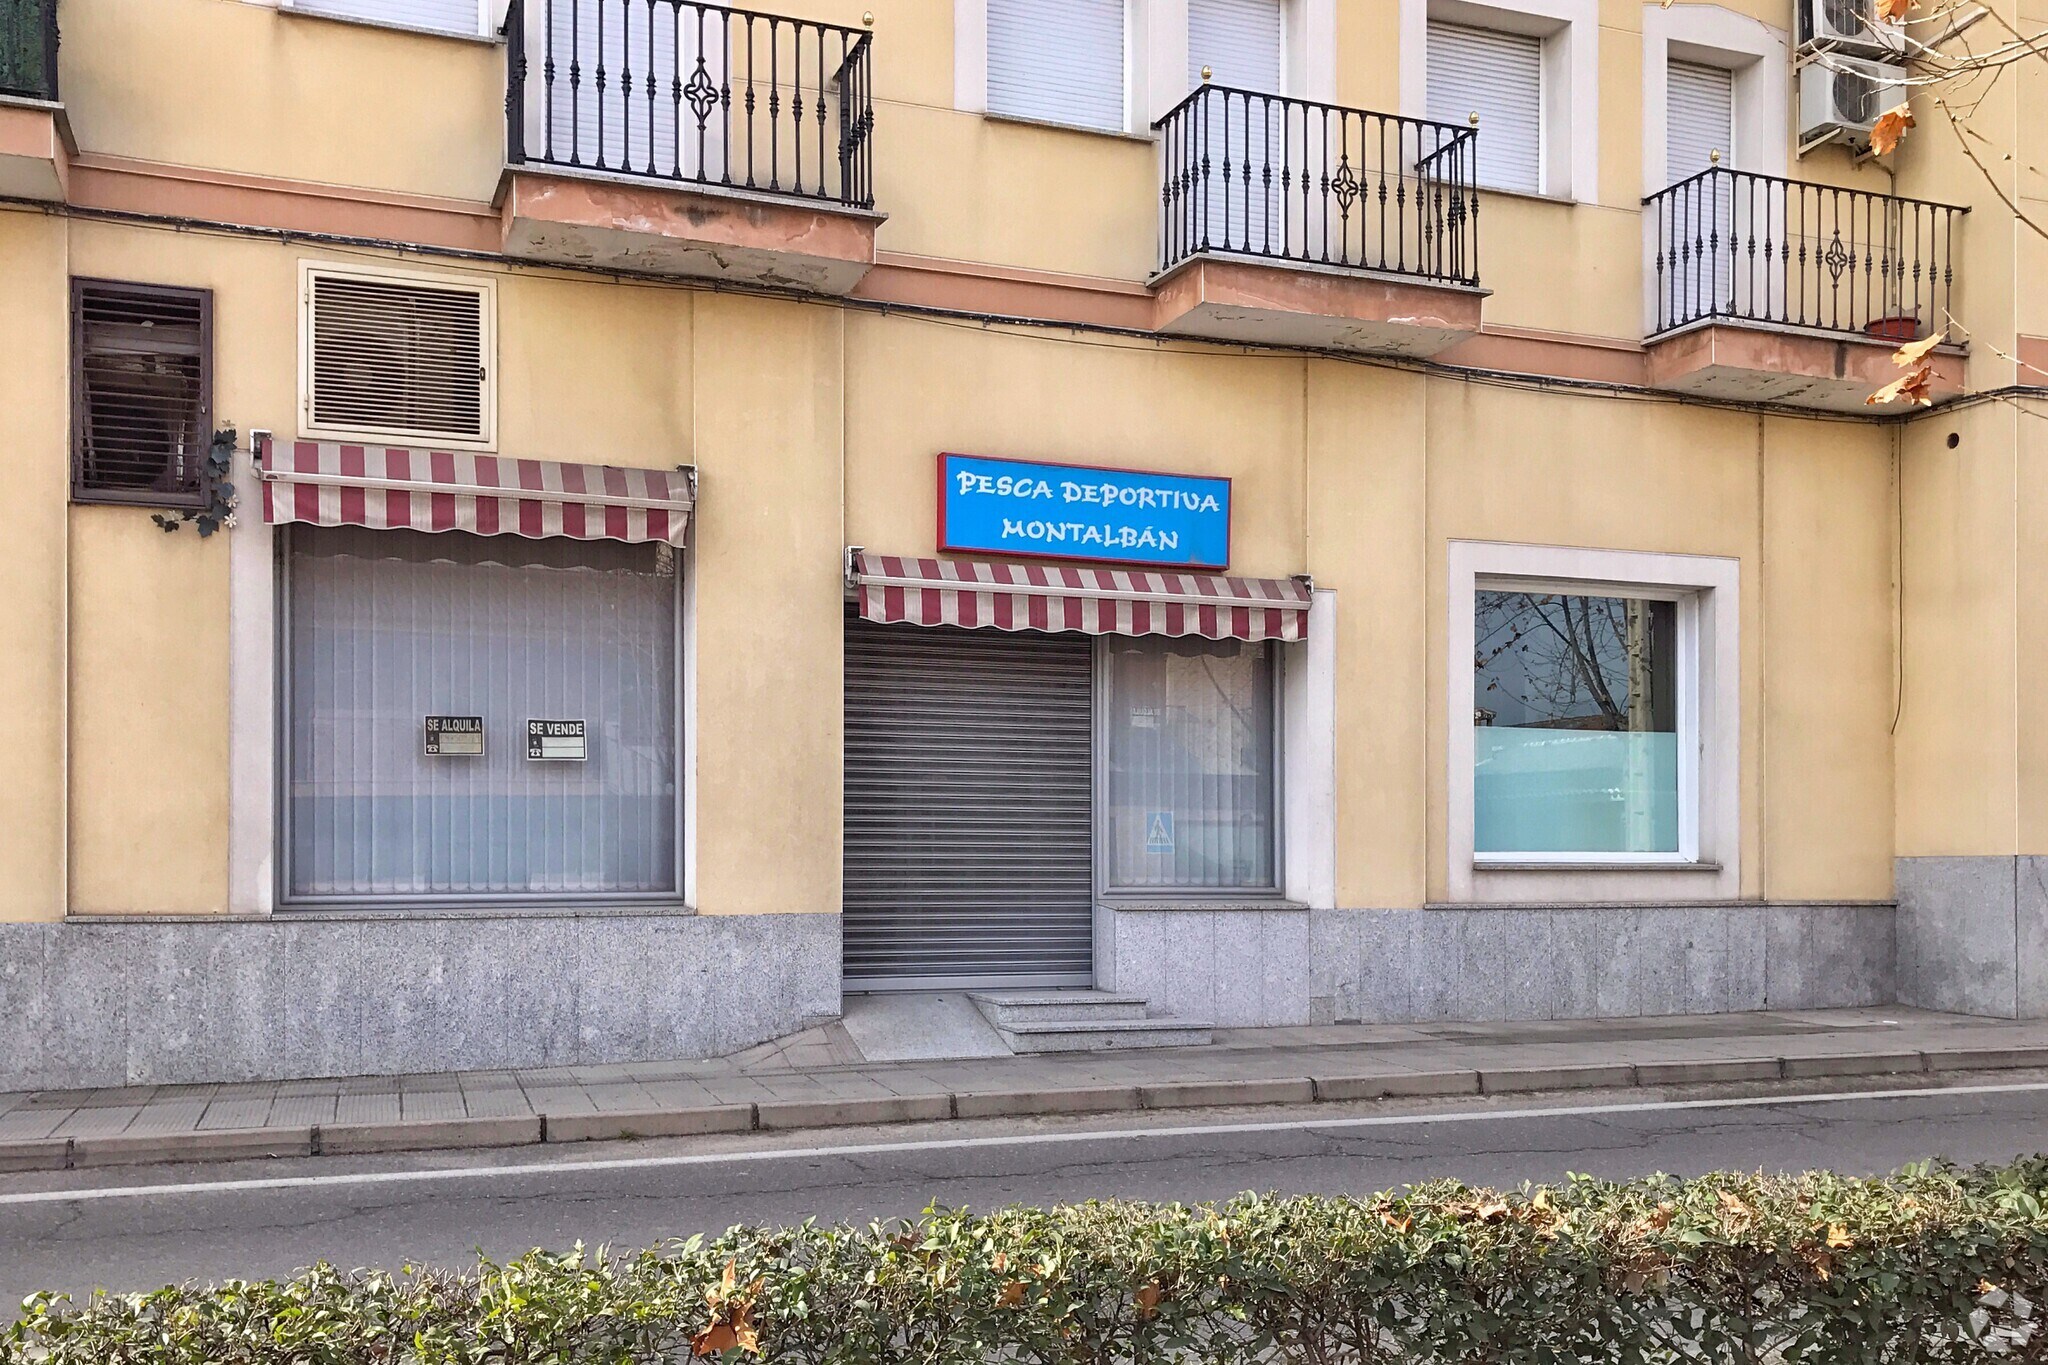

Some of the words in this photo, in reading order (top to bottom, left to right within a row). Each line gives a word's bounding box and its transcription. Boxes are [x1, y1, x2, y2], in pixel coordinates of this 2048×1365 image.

[956, 470, 1054, 499] PESCA
[1060, 481, 1221, 513] DEPORTIVA
[1001, 517, 1179, 551] MONTALBÁN
[427, 719, 439, 731] SE
[441, 719, 481, 732] ALQUILA
[529, 722, 544, 735] SE
[546, 723, 583, 735] VENDE
